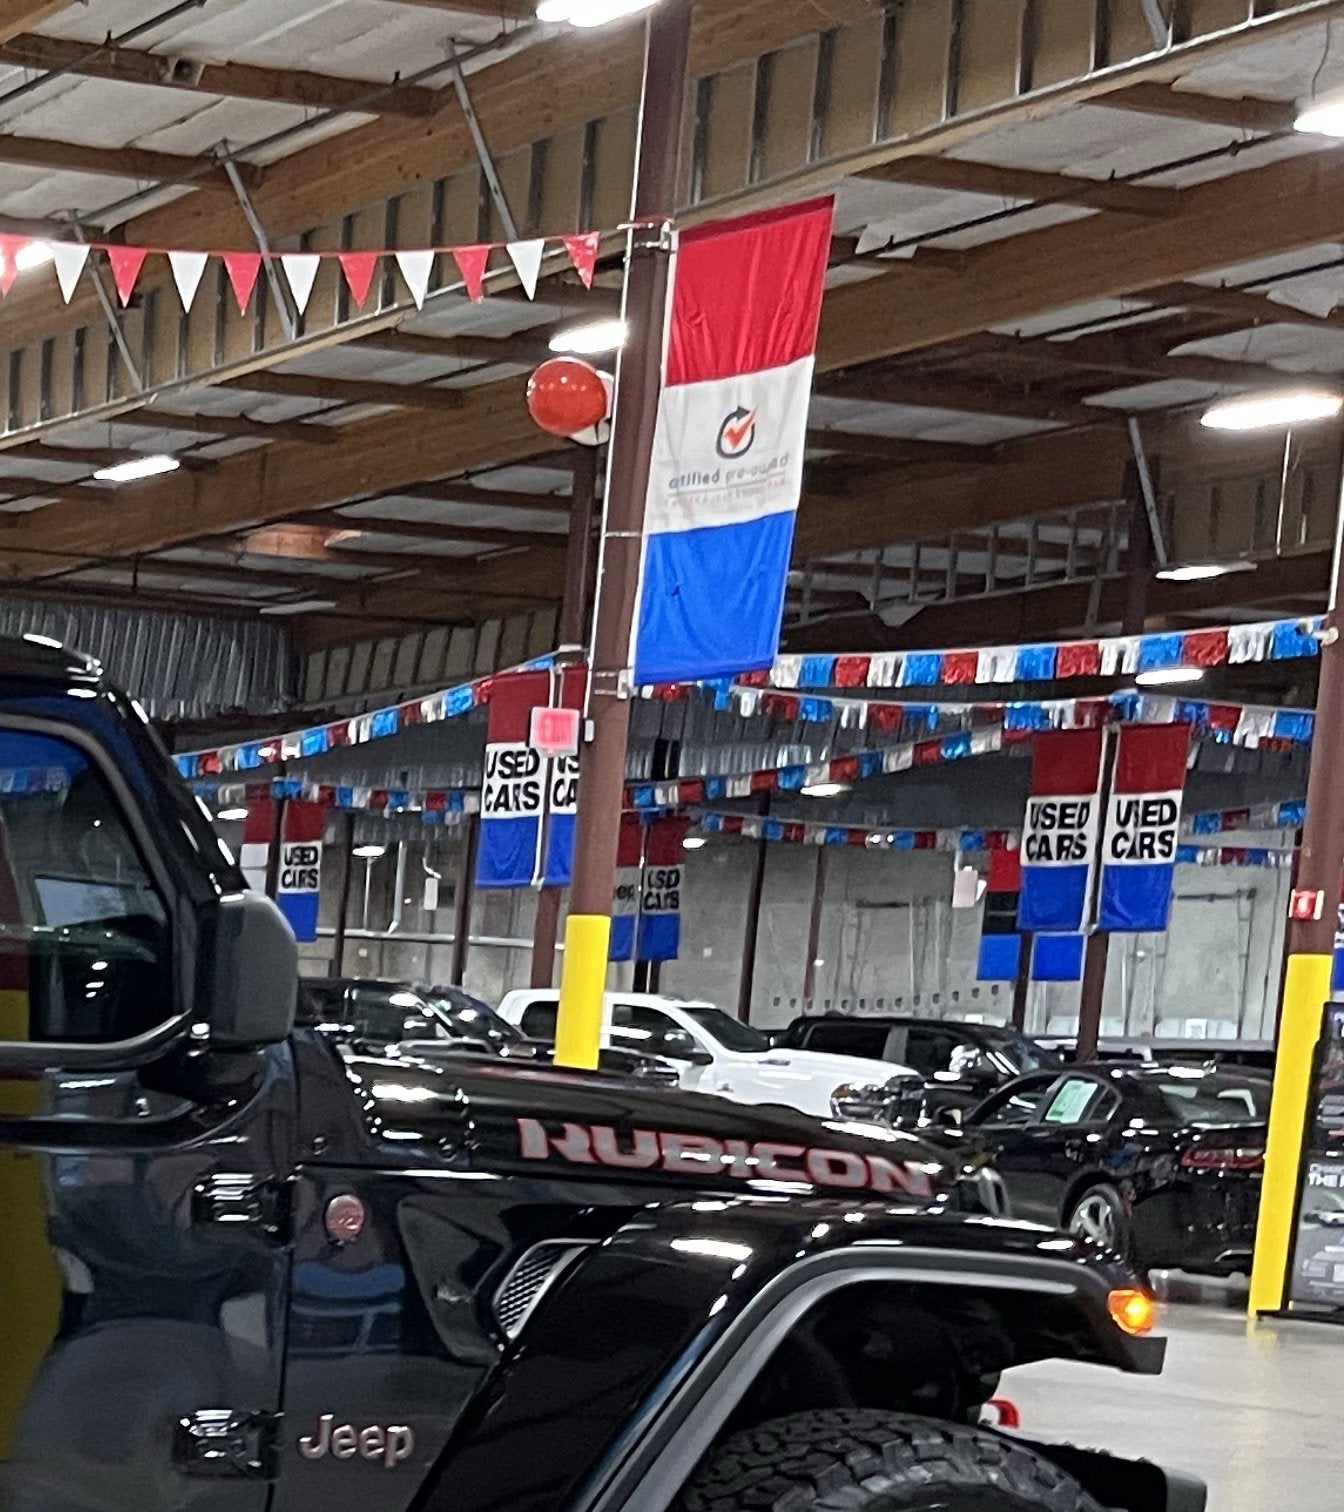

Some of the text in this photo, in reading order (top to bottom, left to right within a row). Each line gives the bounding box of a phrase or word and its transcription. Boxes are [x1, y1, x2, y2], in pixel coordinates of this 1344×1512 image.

[486, 747, 541, 779] USED
[552, 778, 579, 807] CA
[1030, 801, 1091, 830] USED
[1115, 799, 1178, 828] UED
[1025, 832, 1088, 861] CARS
[517, 1118, 933, 1197] RUBICON
[299, 1413, 414, 1468] Jeep
